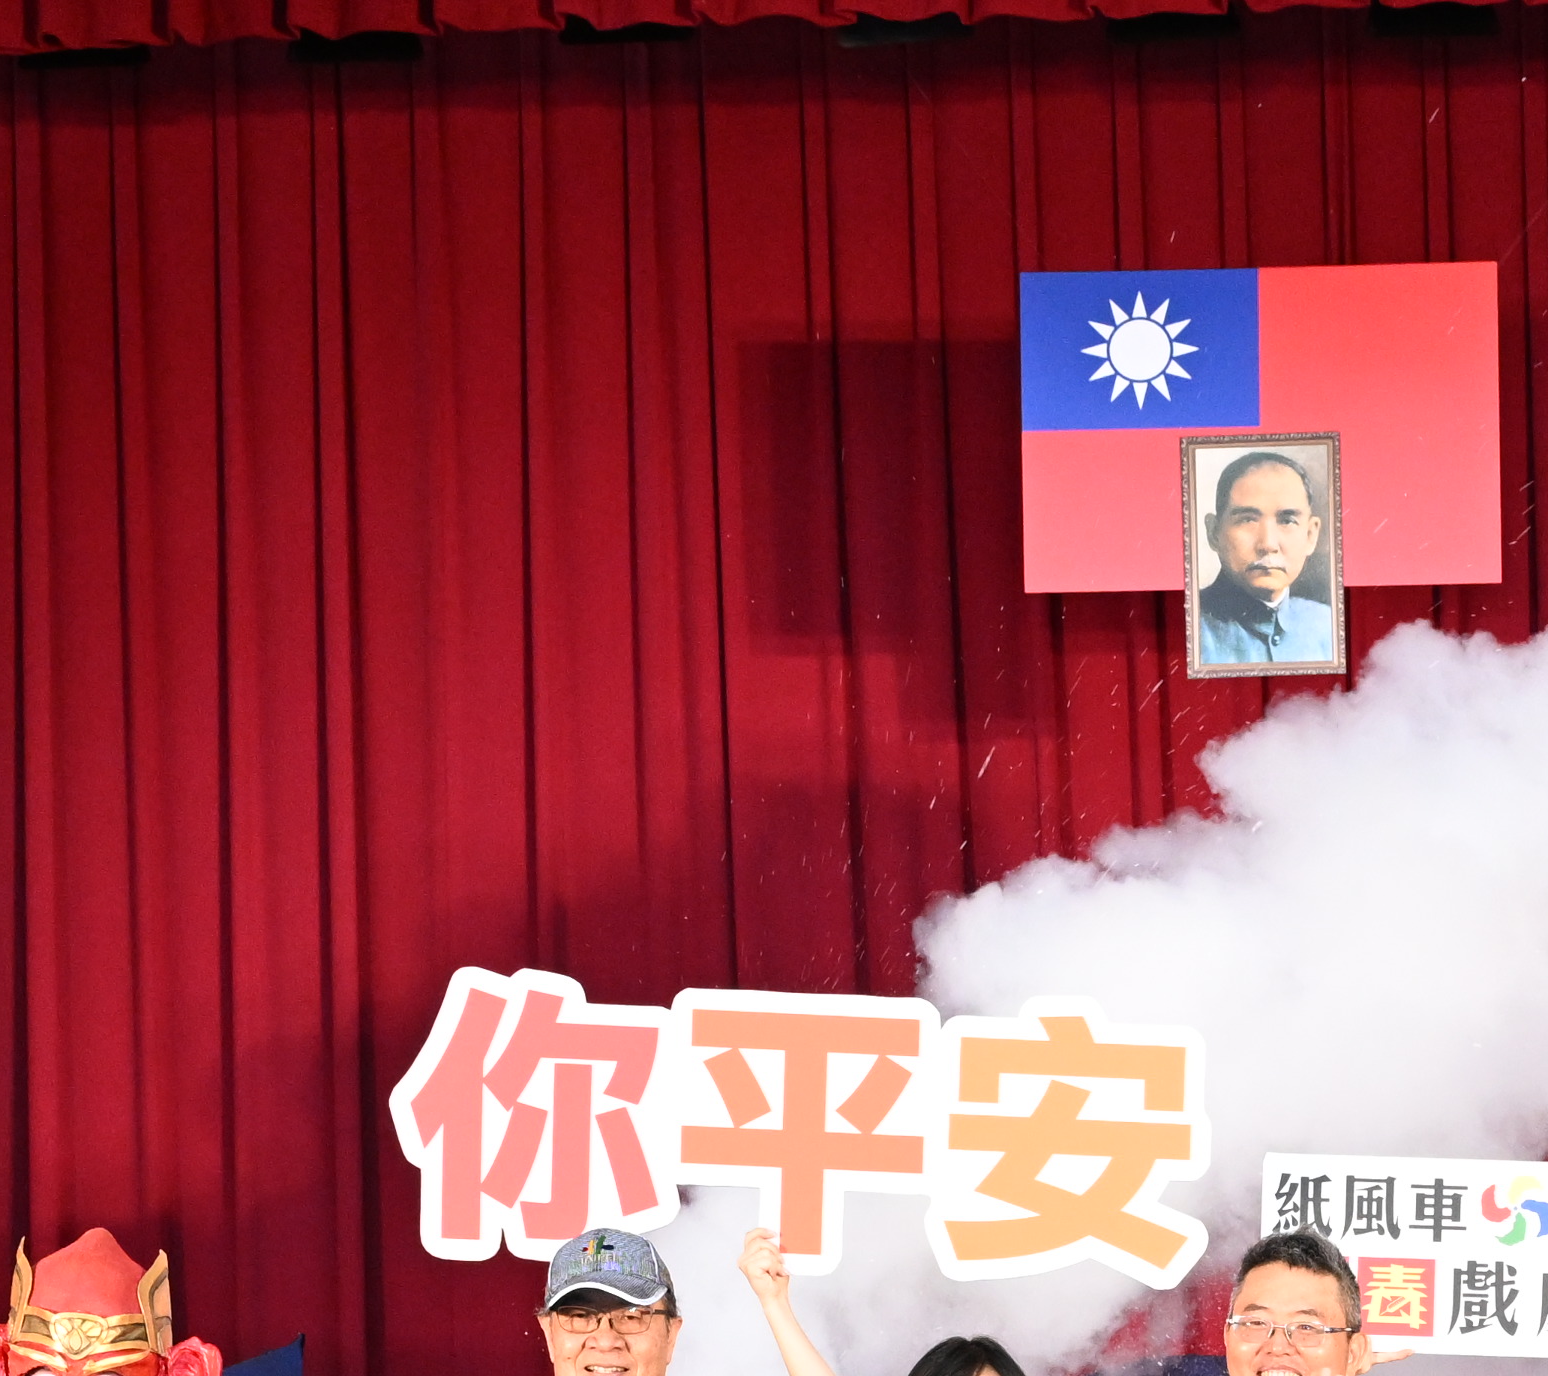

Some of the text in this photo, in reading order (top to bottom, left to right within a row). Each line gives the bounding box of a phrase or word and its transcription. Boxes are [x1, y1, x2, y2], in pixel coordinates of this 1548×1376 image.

[412, 988, 1192, 1272] 你平安
[1273, 1172, 1469, 1243] 紙風車
